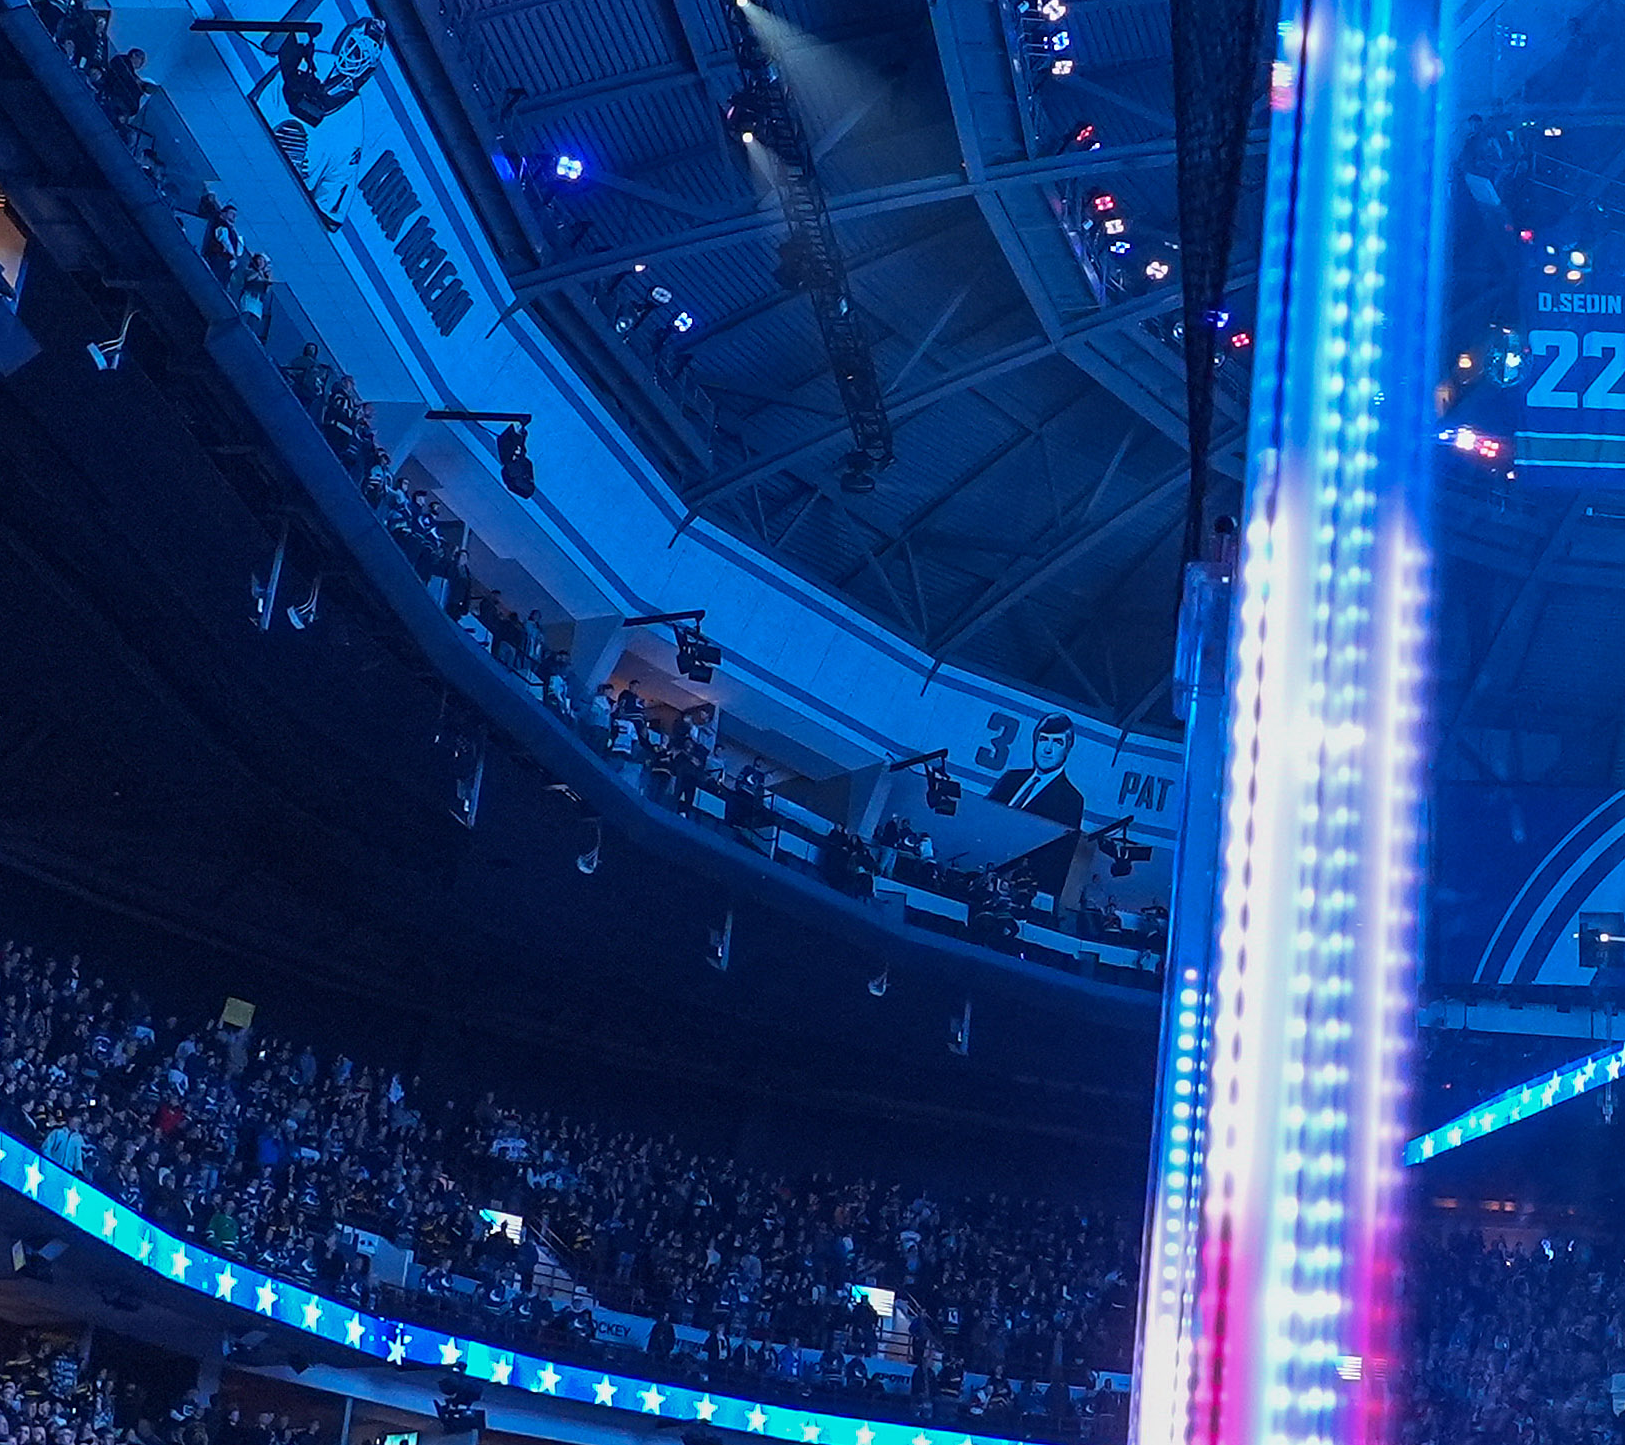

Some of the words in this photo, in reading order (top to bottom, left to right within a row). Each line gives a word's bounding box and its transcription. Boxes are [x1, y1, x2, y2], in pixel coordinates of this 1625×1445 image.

[357, 150, 422, 243] KIRK
[1538, 292, 1622, 314] D.SEDIN
[975, 712, 1021, 772] 3
[1118, 771, 1175, 812] PAT
